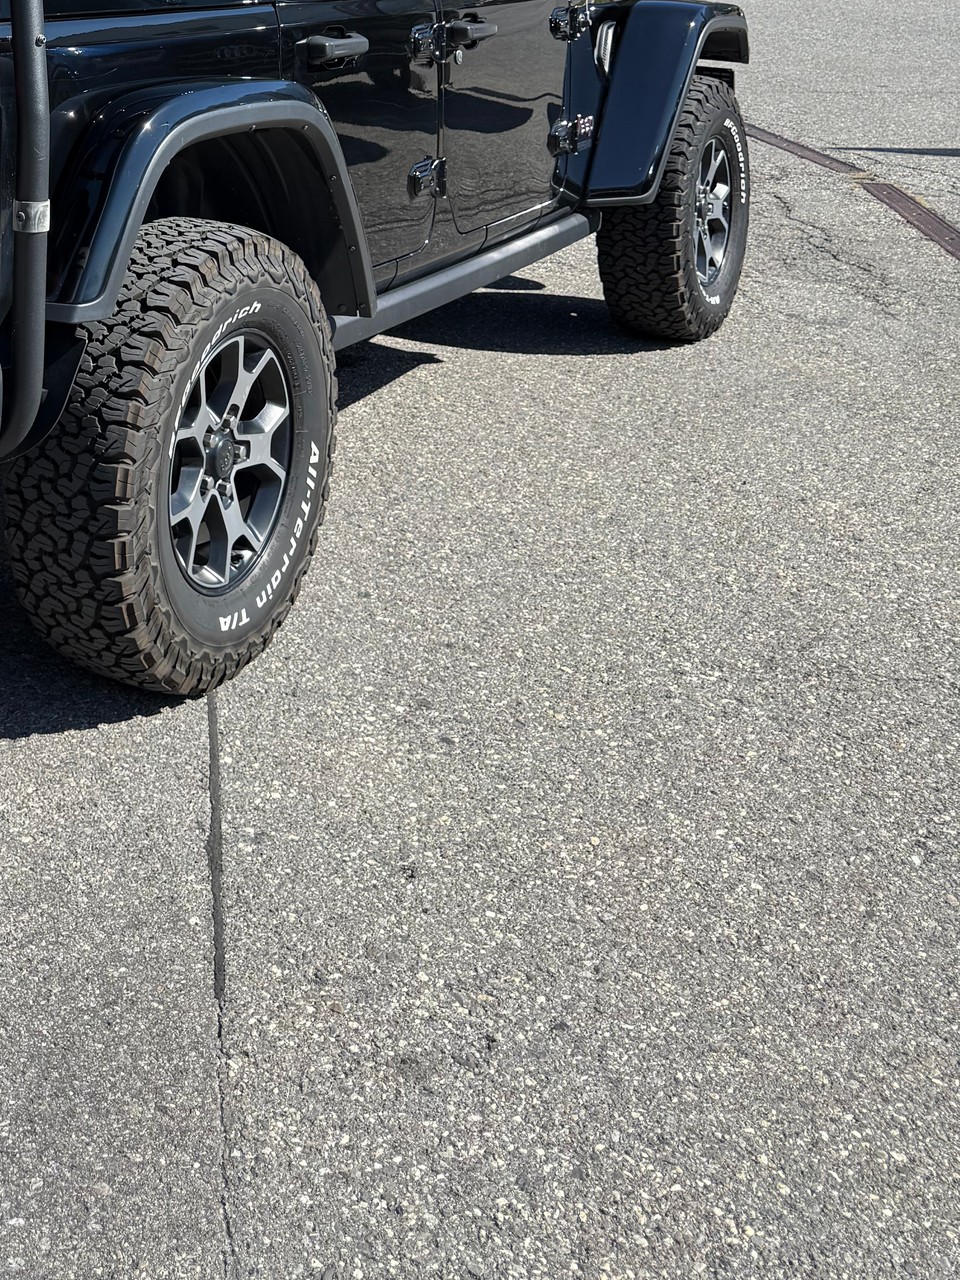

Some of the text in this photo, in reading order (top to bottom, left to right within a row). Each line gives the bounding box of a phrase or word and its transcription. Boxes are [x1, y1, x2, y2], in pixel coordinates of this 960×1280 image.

[713, 118, 747, 204] BFGoodrich
[255, 439, 321, 610] All-Terrain
[218, 607, 251, 633] T/A
